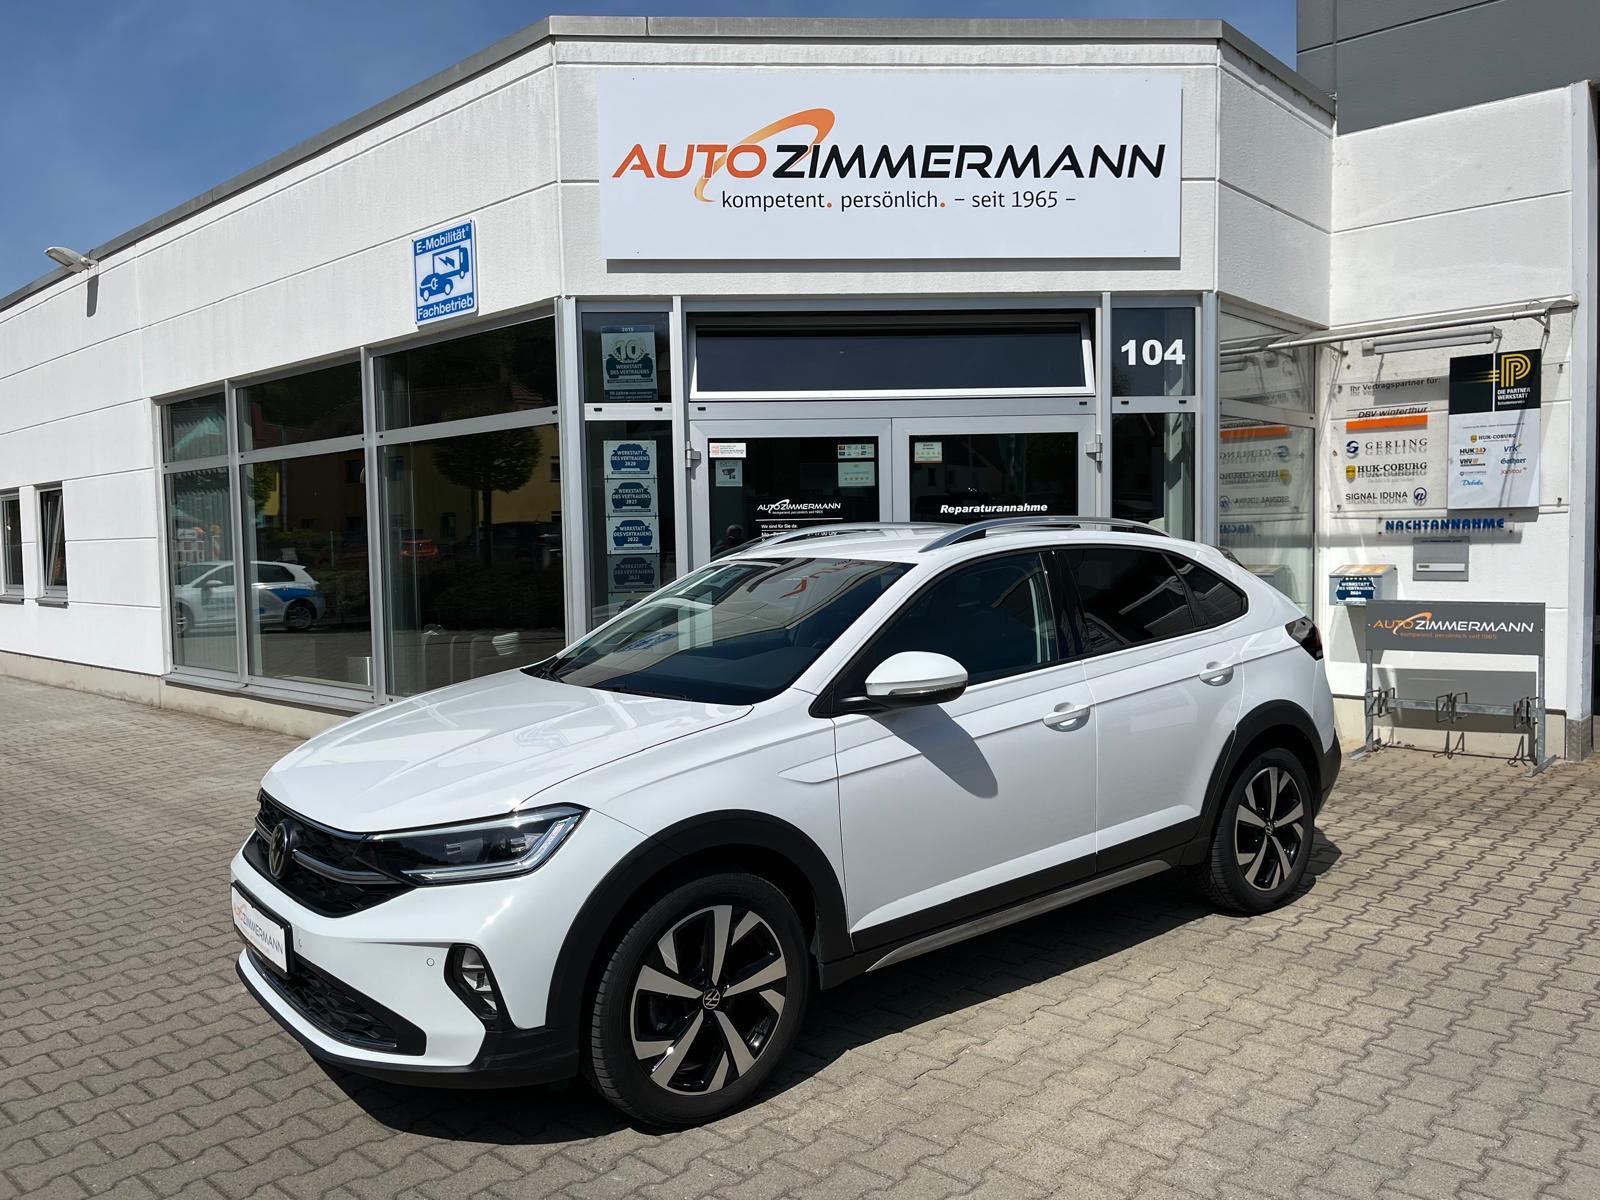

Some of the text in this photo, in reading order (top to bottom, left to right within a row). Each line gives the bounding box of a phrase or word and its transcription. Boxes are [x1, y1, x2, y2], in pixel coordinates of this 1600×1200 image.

[611, 143, 1166, 179] AUTO ZIMMERMANN
[722, 189, 833, 212] kompetent.
[840, 189, 946, 212] persönlich.
[971, 191, 1005, 208] seit
[1011, 190, 1059, 208] 1965
[417, 297, 474, 320] Fachbetrieb
[1120, 338, 1186, 366] 104
[1362, 379, 1425, 391] Vertragspartner
[1426, 377, 1441, 385] für:
[1506, 386, 1531, 394] PARTNER
[1497, 392, 1529, 400] WERKSTATT
[1365, 438, 1428, 450] GERLING
[1357, 461, 1428, 473] HUK-COBURG
[1345, 491, 1408, 500] SIGNAL IDUNA
[757, 502, 841, 511] AUTO ZIMMERMANN
[940, 503, 1048, 515] Reparaturannahme
[1385, 517, 1505, 531] NACHTANNAHME
[1373, 619, 1535, 633] AUTO ZIMMERMANN
